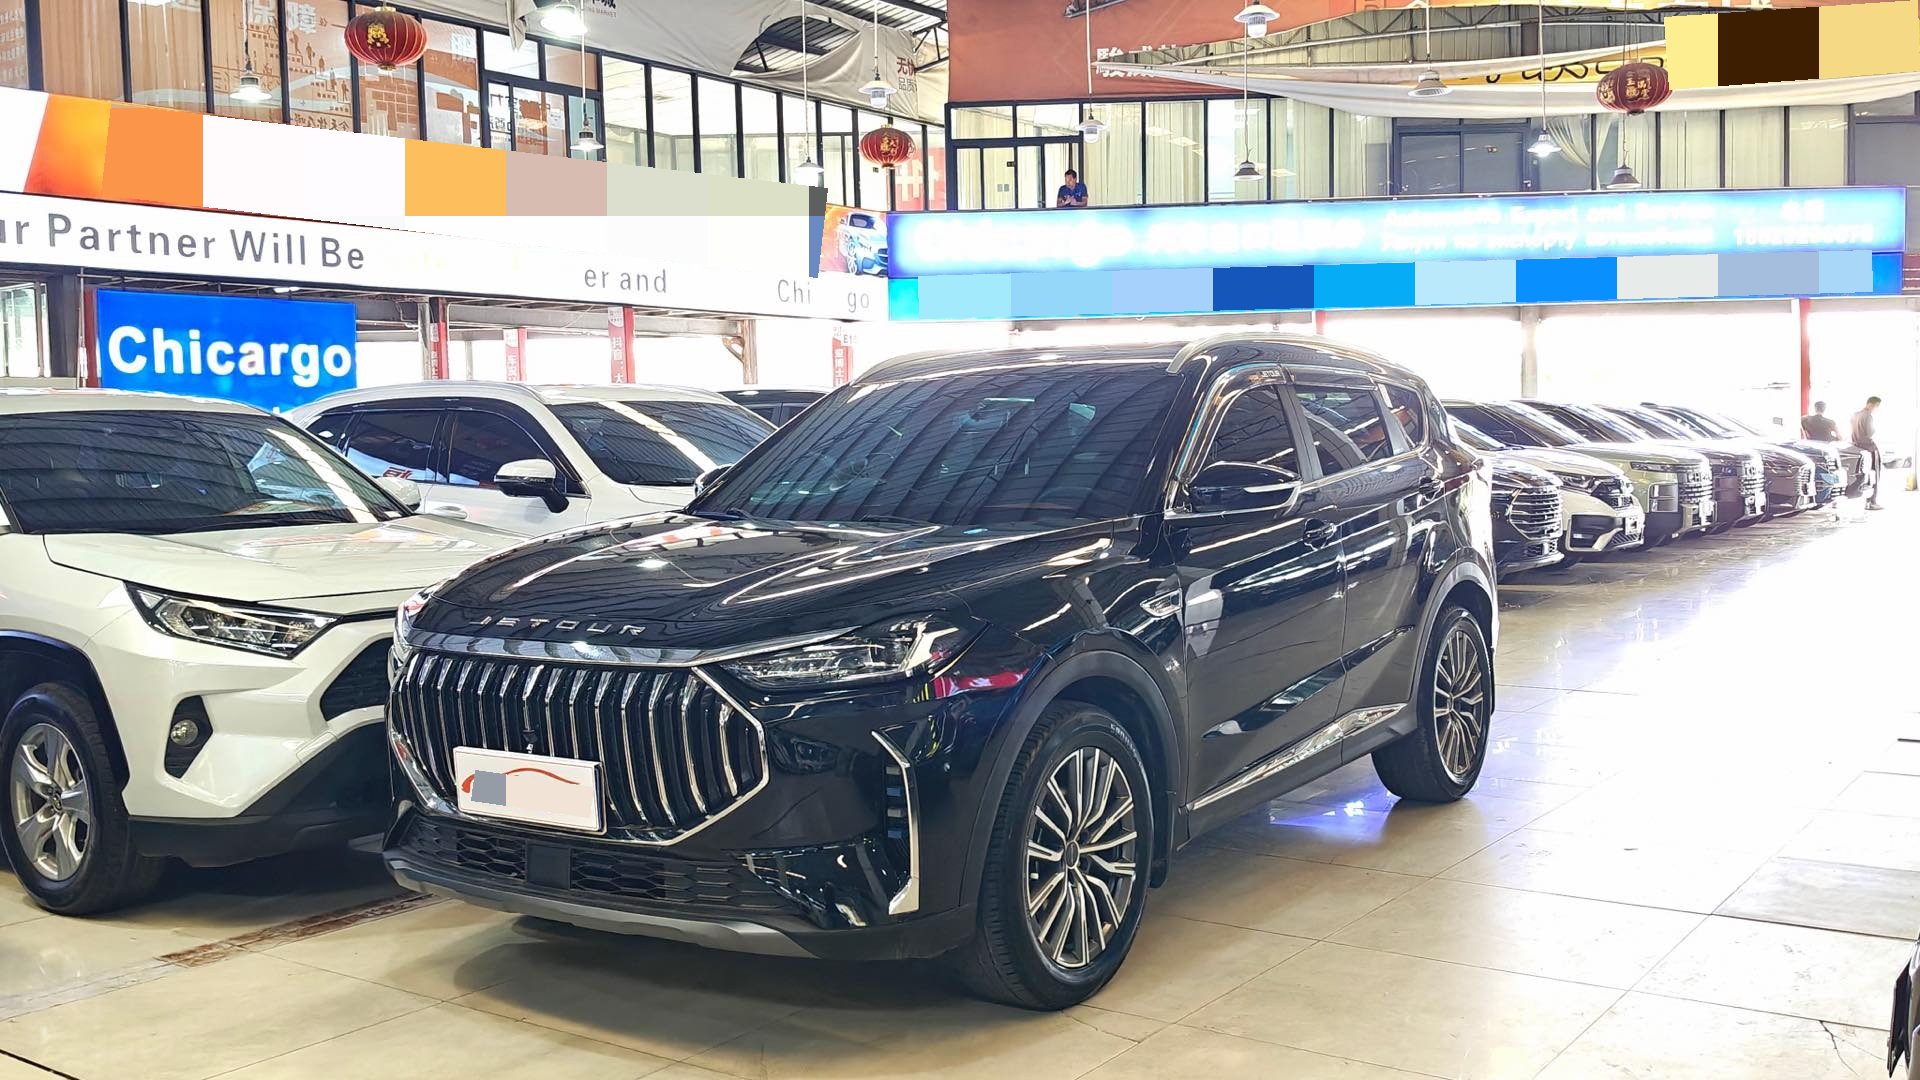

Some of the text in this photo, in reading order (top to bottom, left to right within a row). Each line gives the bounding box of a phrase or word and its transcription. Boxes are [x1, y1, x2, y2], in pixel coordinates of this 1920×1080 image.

[47, 212, 216, 259] Partner
[230, 229, 306, 265] Will
[321, 236, 364, 270] Be
[619, 268, 667, 293] and
[108, 325, 352, 388] Chicargo
[469, 615, 647, 636] JETOUR
